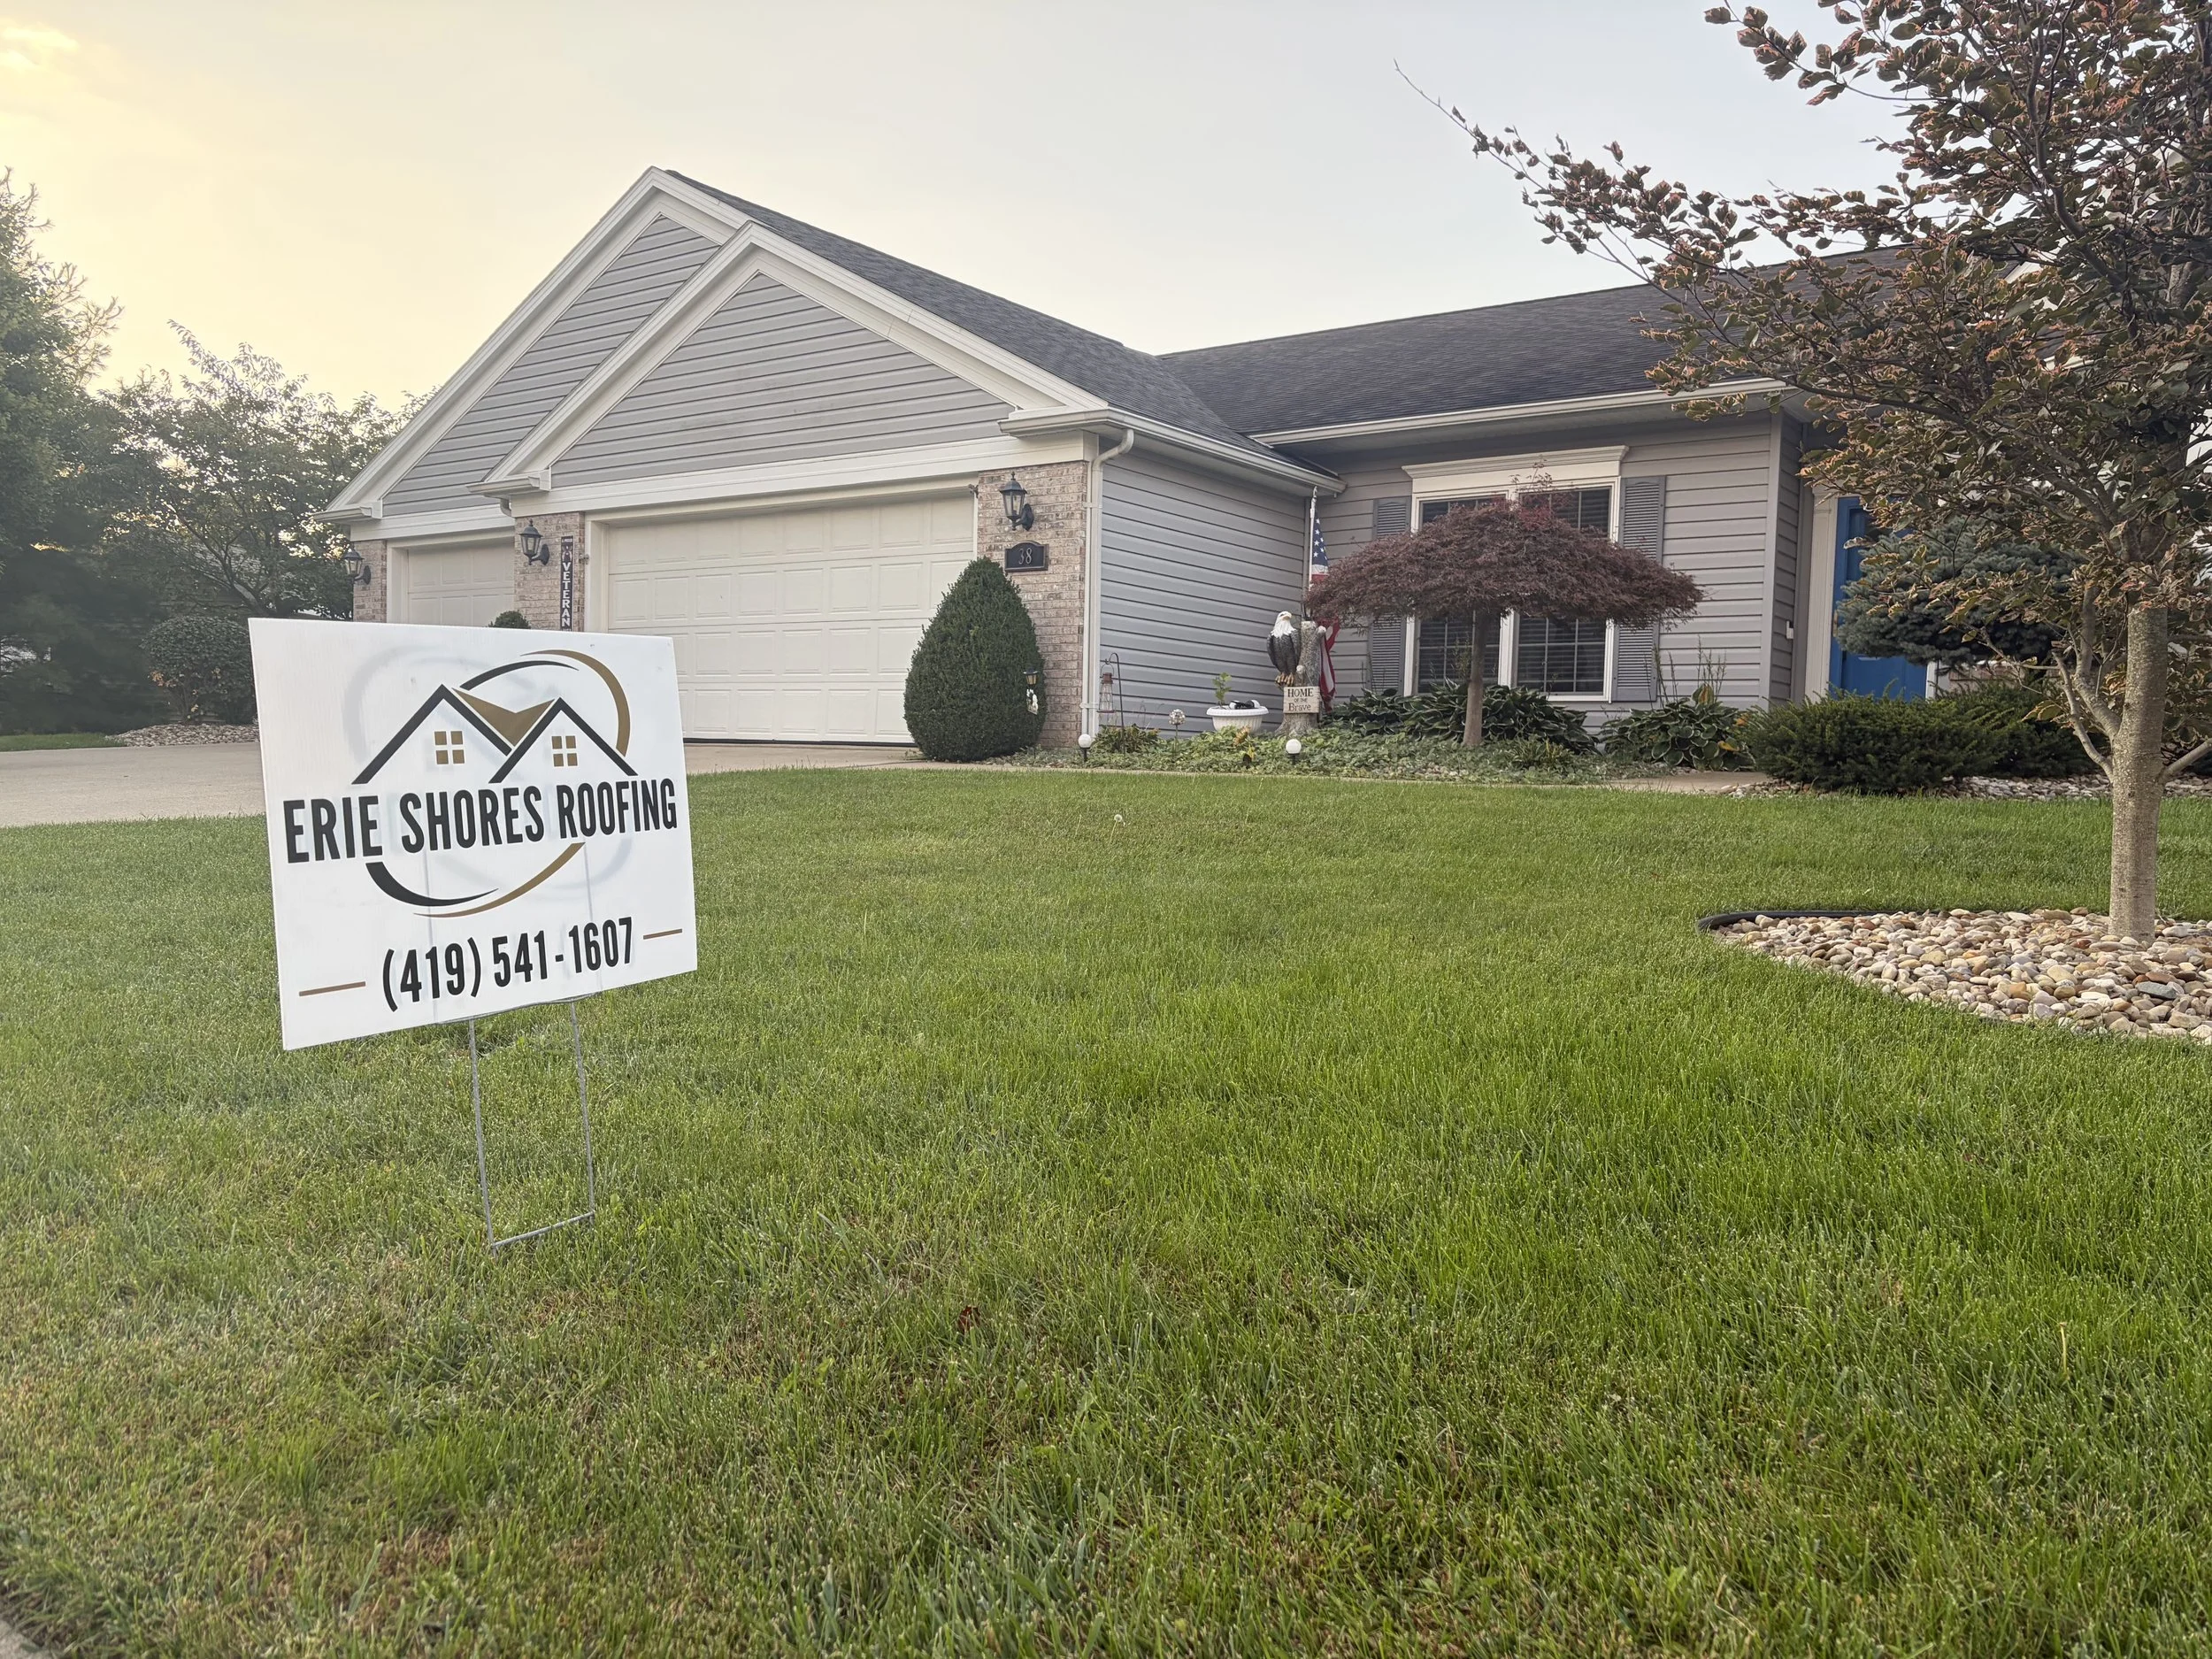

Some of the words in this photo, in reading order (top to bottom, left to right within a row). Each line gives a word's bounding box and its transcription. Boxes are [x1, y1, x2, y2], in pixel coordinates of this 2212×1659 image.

[1018, 547, 1033, 565] 38
[561, 562, 572, 627] VETERAN
[1287, 687, 1314, 697] HOME
[1288, 703, 1311, 711] Brave
[283, 795, 383, 864] ERIE
[399, 785, 544, 854] SHORES
[557, 778, 678, 839] ROOFING
[382, 937, 481, 1012] (419)
[492, 917, 633, 987] 541-1607
